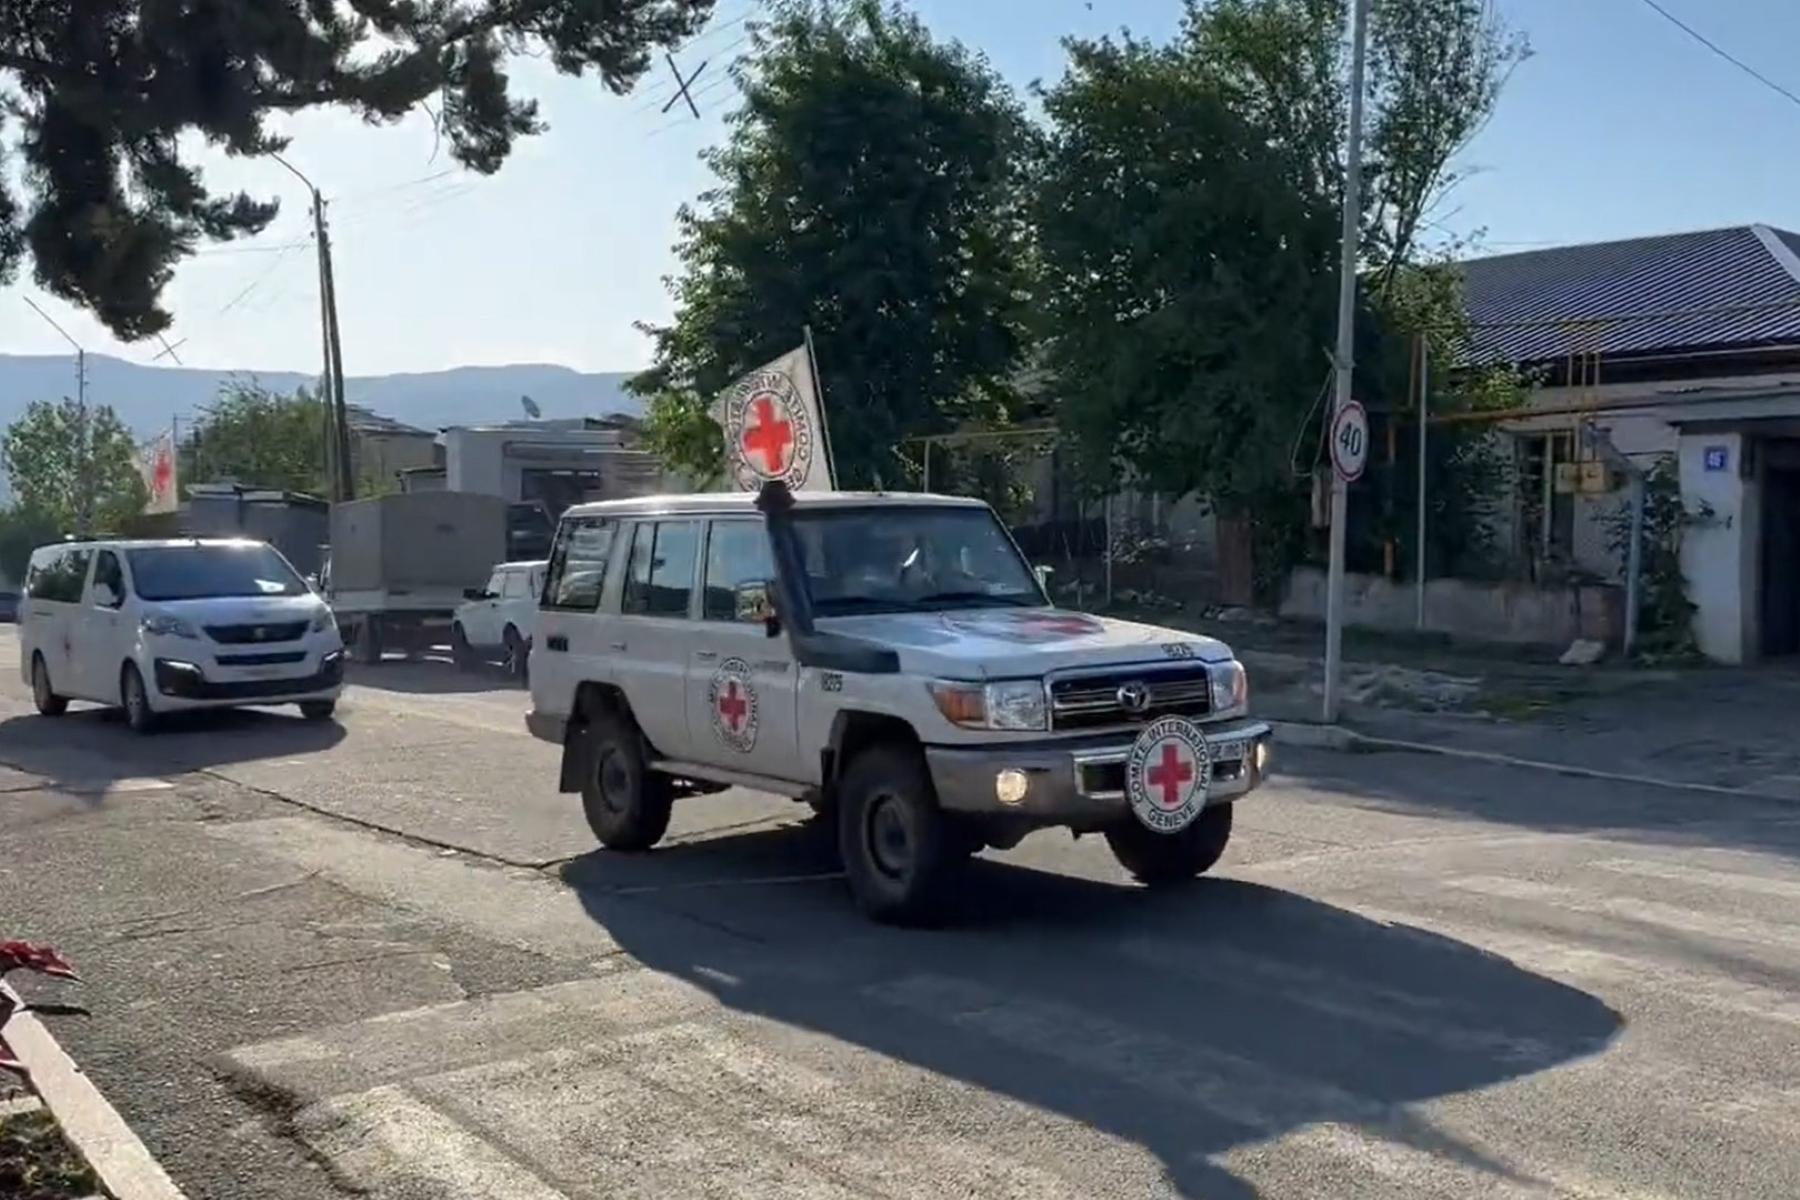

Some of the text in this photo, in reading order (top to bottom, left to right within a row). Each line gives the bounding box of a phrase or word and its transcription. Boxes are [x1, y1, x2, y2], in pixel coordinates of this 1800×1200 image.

[1340, 421, 1361, 456] 40
[1131, 721, 1208, 803] COMITE INTERNATIONAL
[1147, 803, 1196, 828] GENEVE
